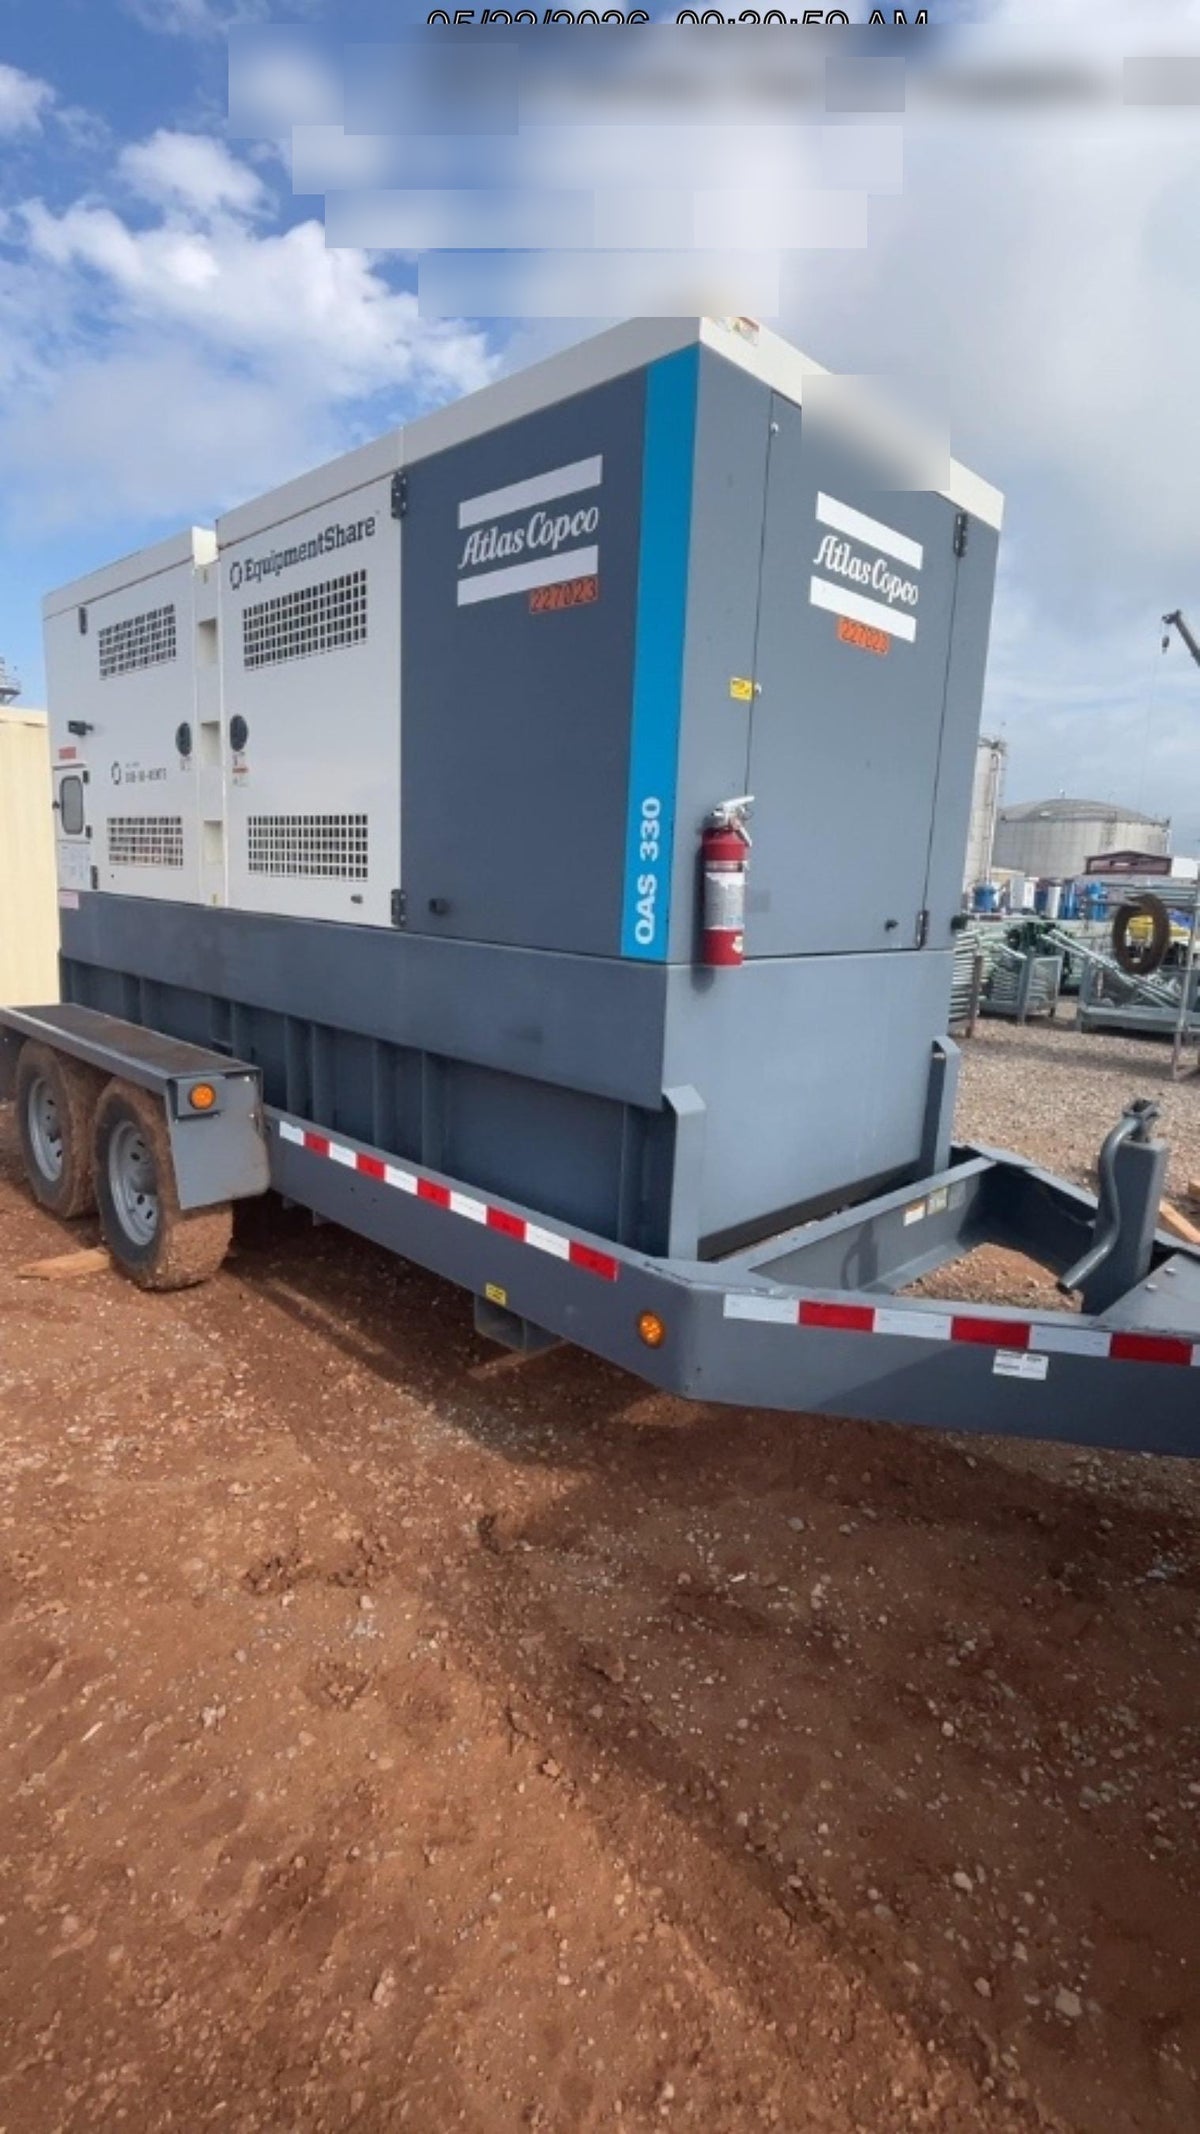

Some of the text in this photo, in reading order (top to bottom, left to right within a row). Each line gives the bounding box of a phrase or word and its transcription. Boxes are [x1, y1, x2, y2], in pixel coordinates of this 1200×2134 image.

[244, 516, 376, 583] EquipmentShare
[458, 507, 599, 570] Atlas Copco
[813, 535, 919, 606] Atlas Copco
[531, 576, 597, 612] 227023
[640, 797, 661, 862] 330
